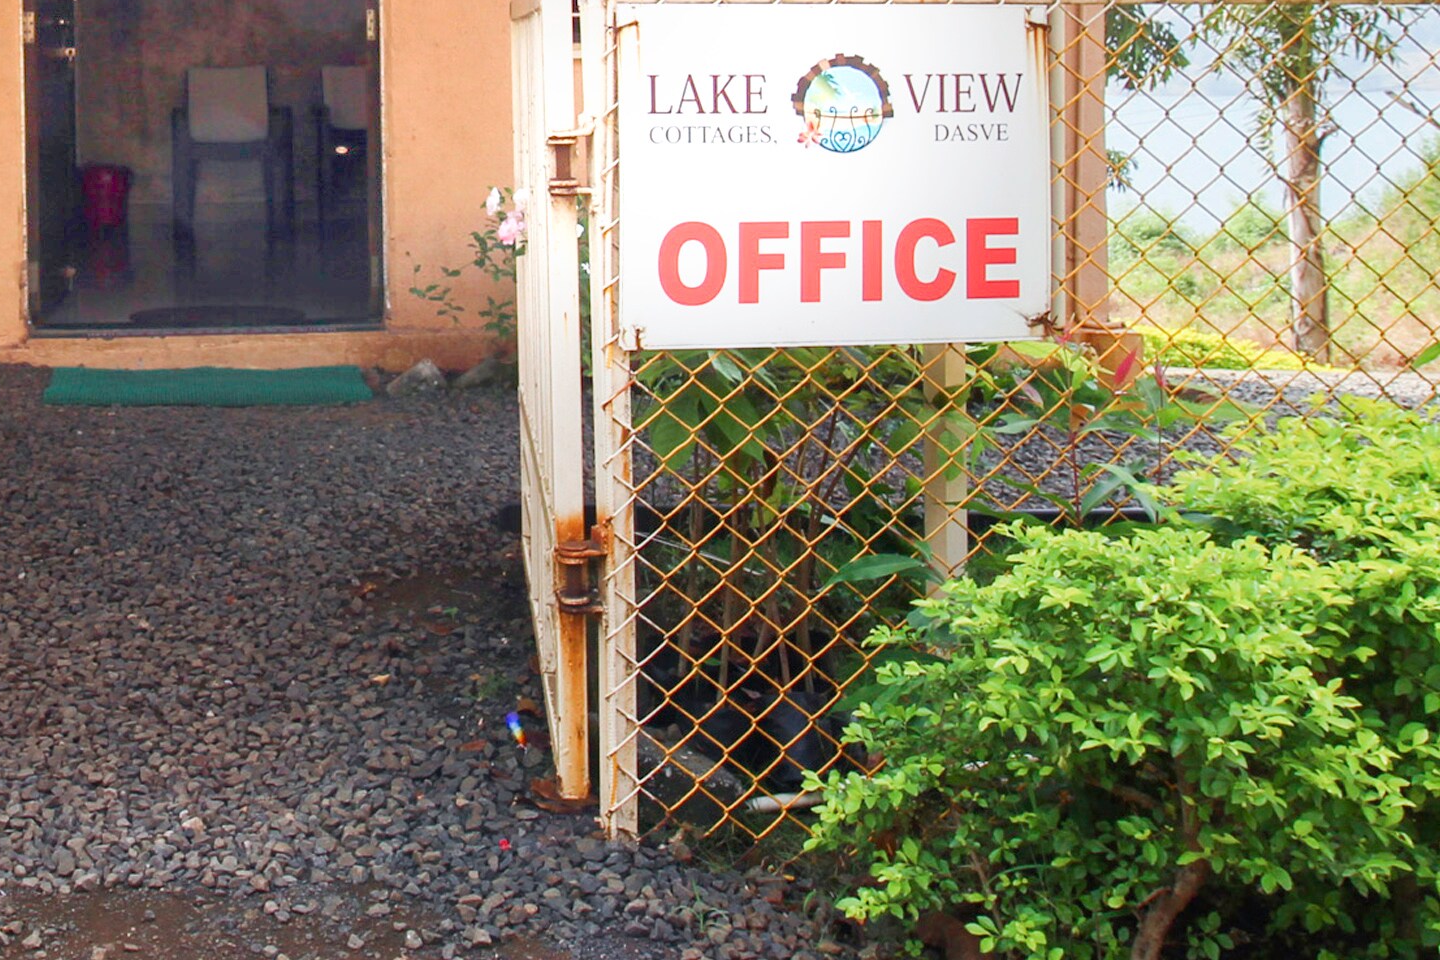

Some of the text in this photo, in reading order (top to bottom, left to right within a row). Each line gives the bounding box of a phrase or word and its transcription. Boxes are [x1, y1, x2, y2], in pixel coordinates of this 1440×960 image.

[647, 73, 1024, 115] LAKE VIEW
[934, 123, 1010, 142] DASVE
[658, 217, 1021, 306] OFFICE
